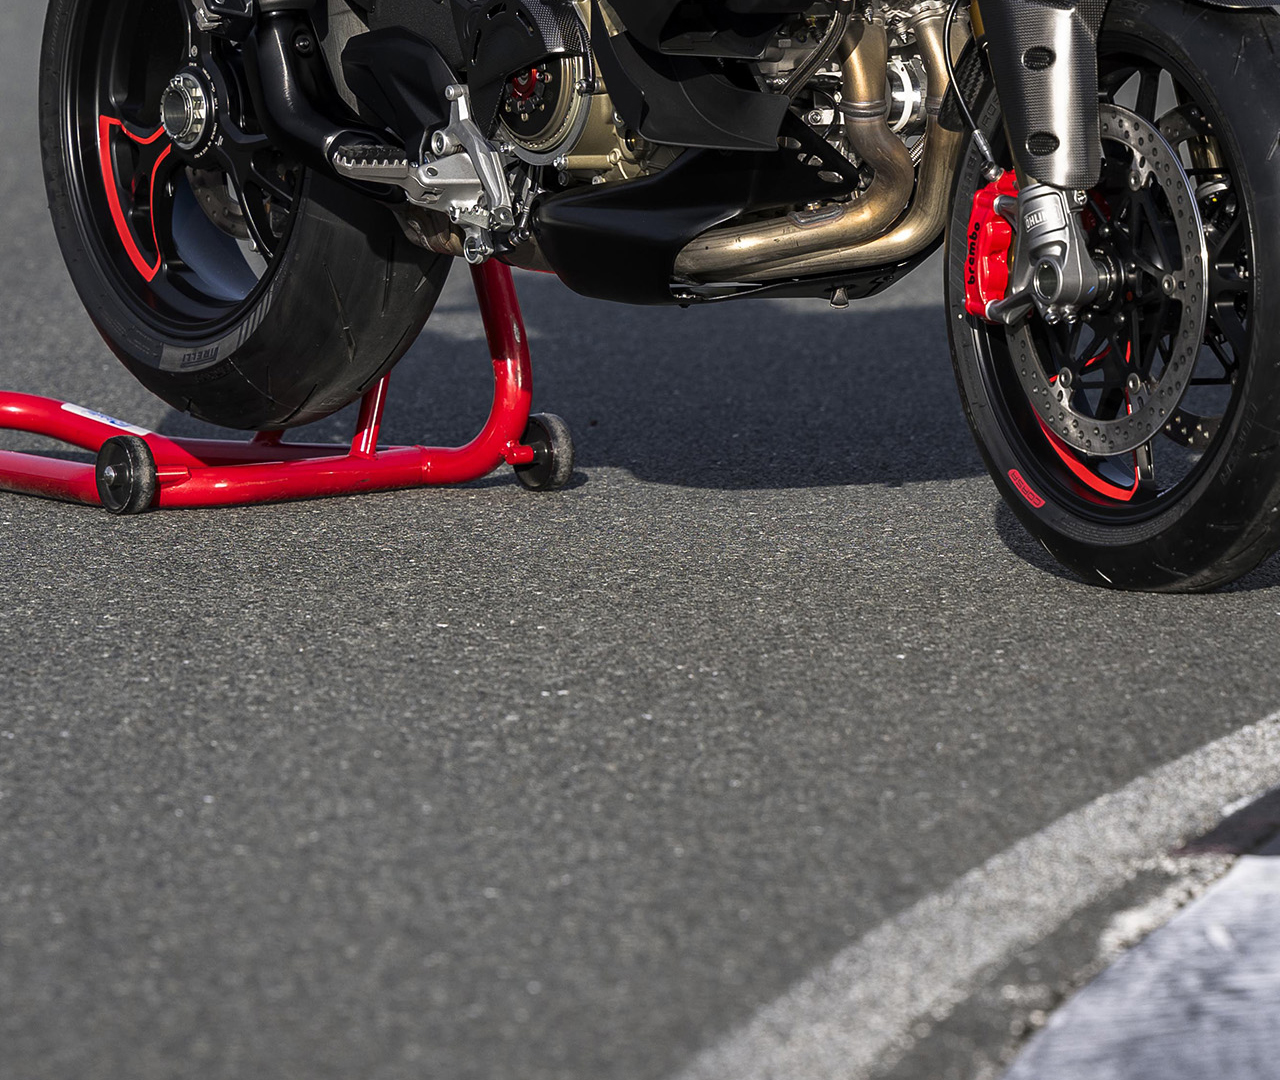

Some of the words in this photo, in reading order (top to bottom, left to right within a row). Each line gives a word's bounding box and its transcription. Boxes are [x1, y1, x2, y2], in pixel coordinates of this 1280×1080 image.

[968, 222, 980, 285] brembo
[180, 346, 219, 368] PIRELLI
[1011, 471, 1041, 506] CORSA
